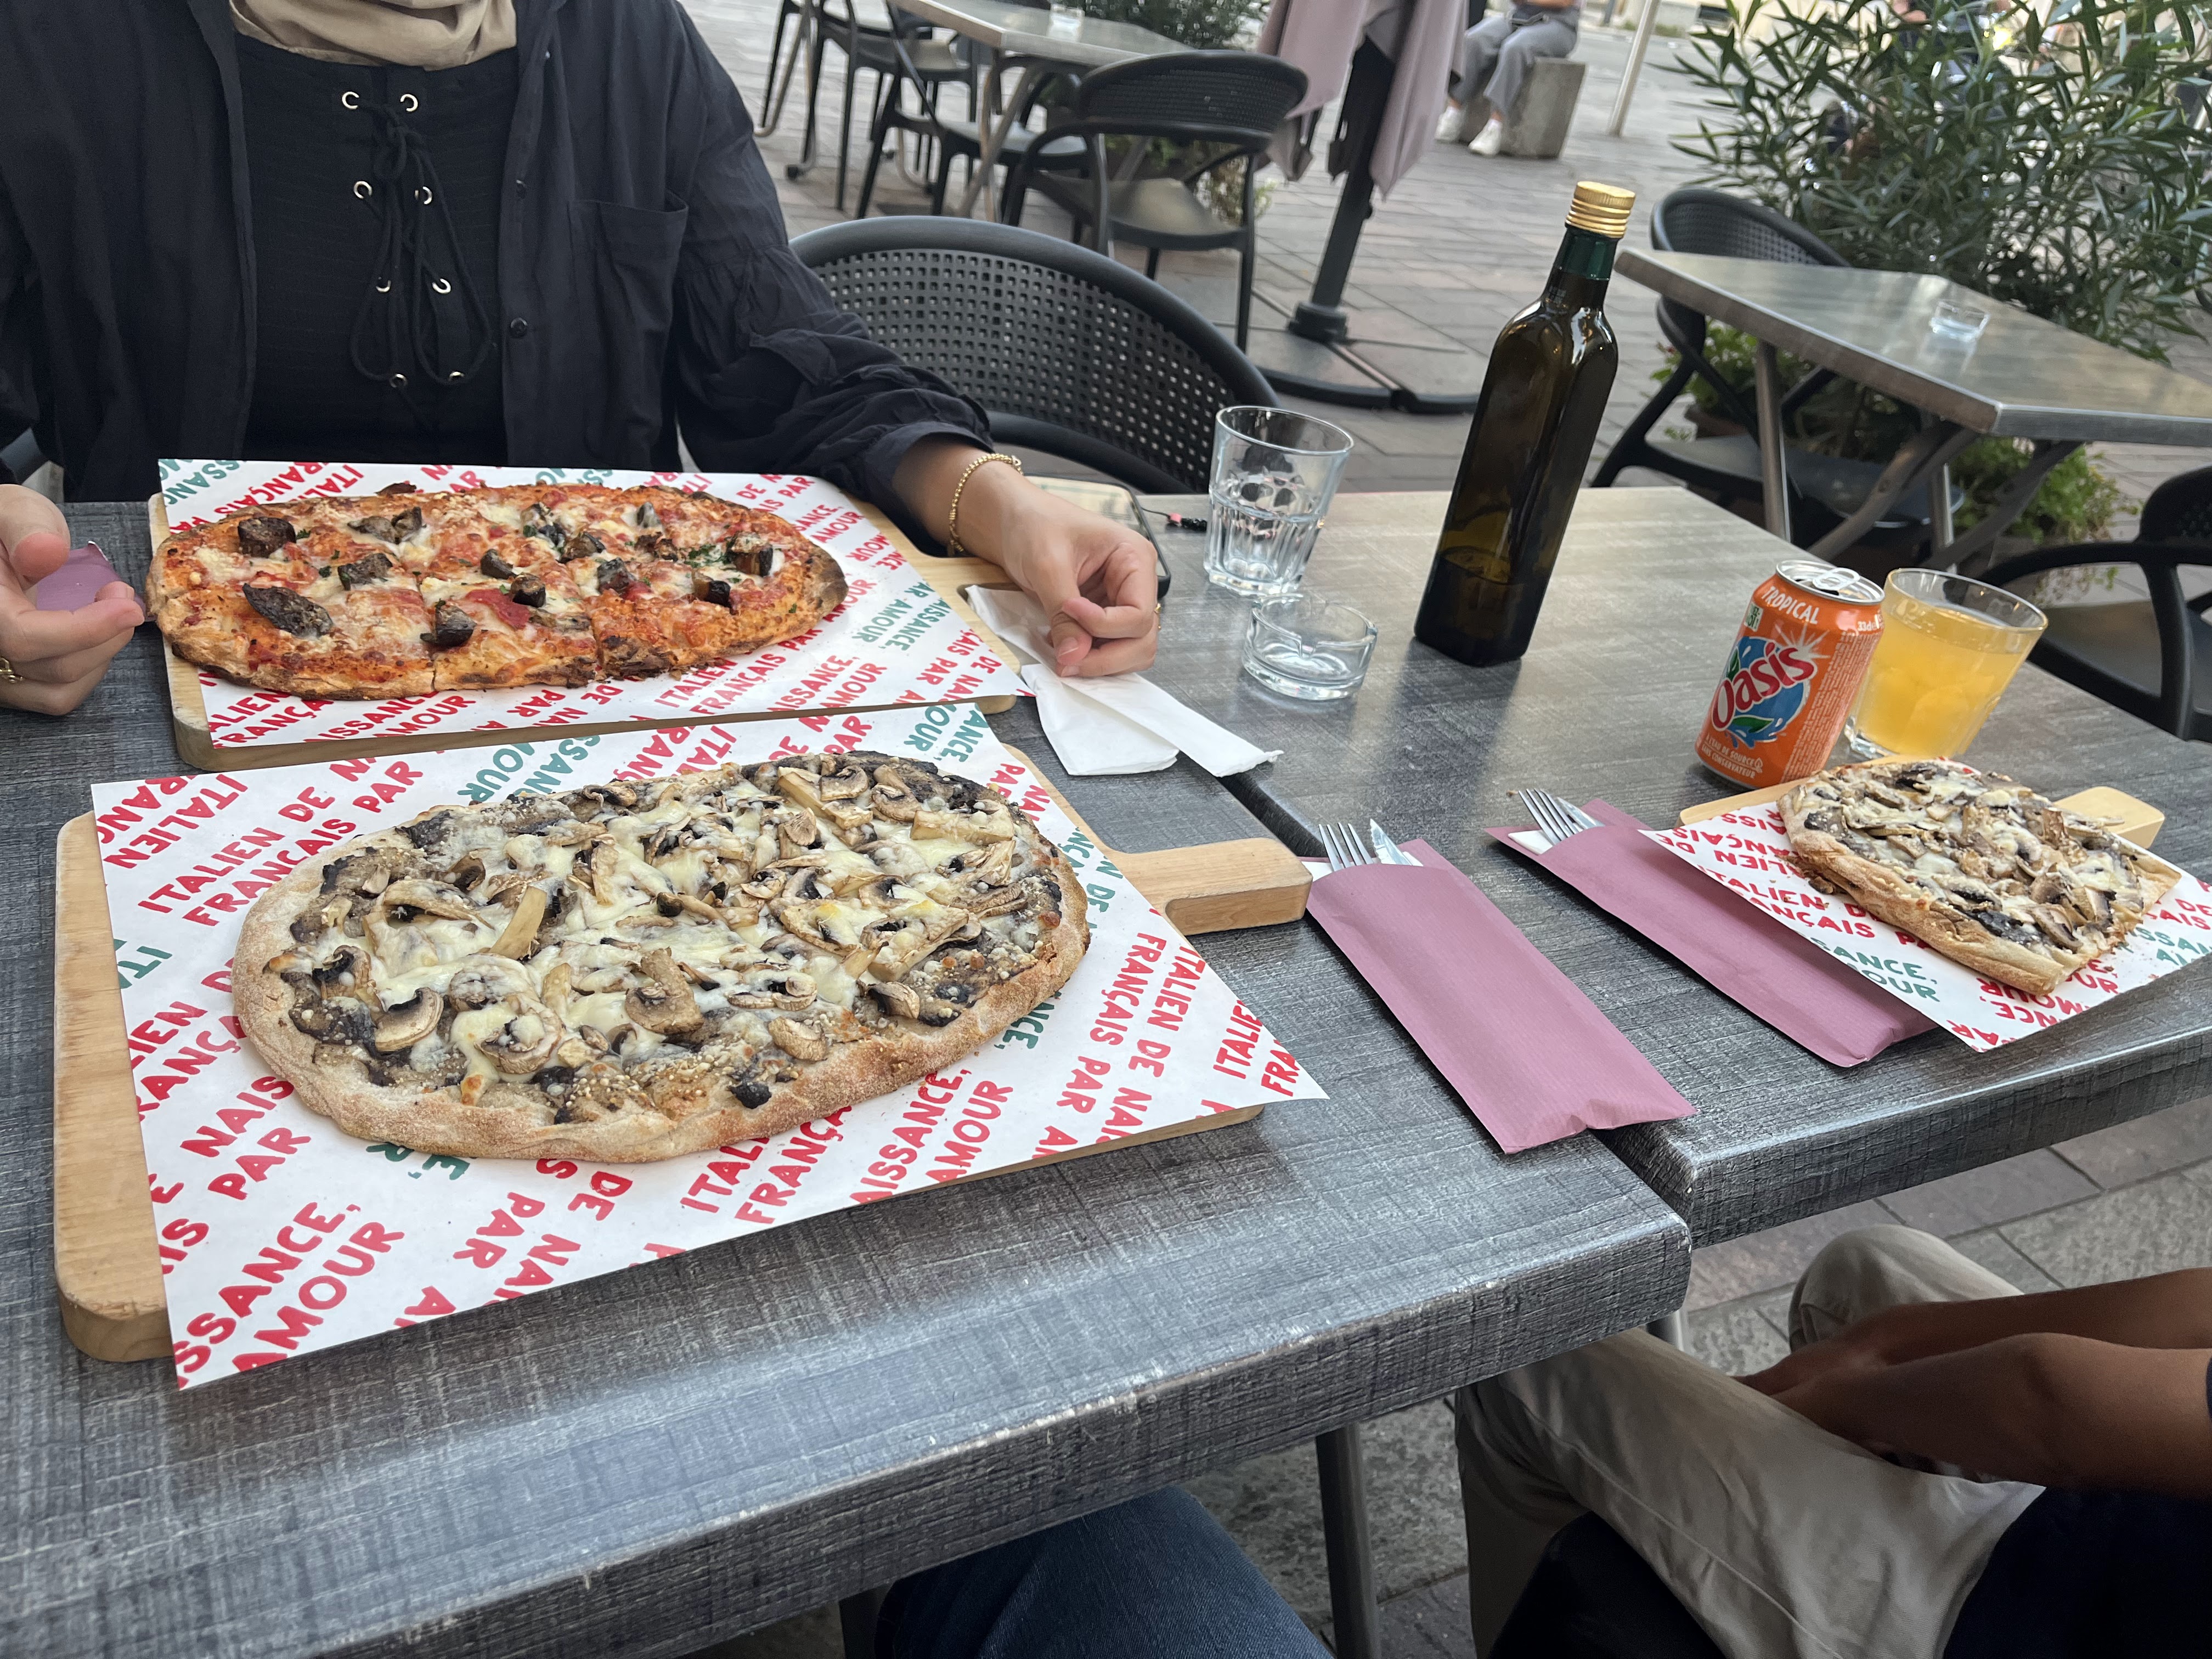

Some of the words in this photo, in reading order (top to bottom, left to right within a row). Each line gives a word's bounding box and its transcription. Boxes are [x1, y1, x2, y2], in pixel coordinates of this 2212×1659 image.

[214, 461, 329, 514] RANÇAIS
[736, 483, 766, 500] DE
[777, 476, 815, 498] PAR
[811, 511, 865, 544] AMOUR
[904, 579, 935, 598] AR
[1761, 586, 1820, 625] TROPICAL
[852, 599, 913, 642] AMOUR
[654, 657, 738, 708] ITALIEN
[689, 653, 787, 715] FRANÇAIS
[916, 657, 958, 685] PAR
[970, 656, 1002, 674] DE
[1712, 641, 1815, 729] Oasis
[506, 689, 566, 717] PAR
[581, 685, 624, 705] DE
[823, 715, 873, 754] PAR
[1712, 752, 1756, 779] CONSERVATEUR
[1730, 751, 1755, 767] SOURCE
[352, 761, 423, 813] PAR
[104, 774, 248, 868] ITALIEN
[1656, 833, 1695, 854] DE
[138, 827, 285, 913] ITALIEN
[278, 787, 336, 822] DE
[1086, 883, 1116, 912] DE
[1090, 933, 1167, 1046] FRANÇAIS
[1147, 946, 1206, 1031] ITALIEN
[1128, 1039, 1171, 1078] DE
[1213, 1000, 1263, 1080] ITALIE
[1057, 1056, 1110, 1114] PAR
[926, 1080, 1013, 1183] AMOUR
[207, 1127, 312, 1200] PAR
[568, 1171, 633, 1221] DE
[453, 1192, 545, 1269] PAR
[232, 1222, 405, 1372] AMOUR
